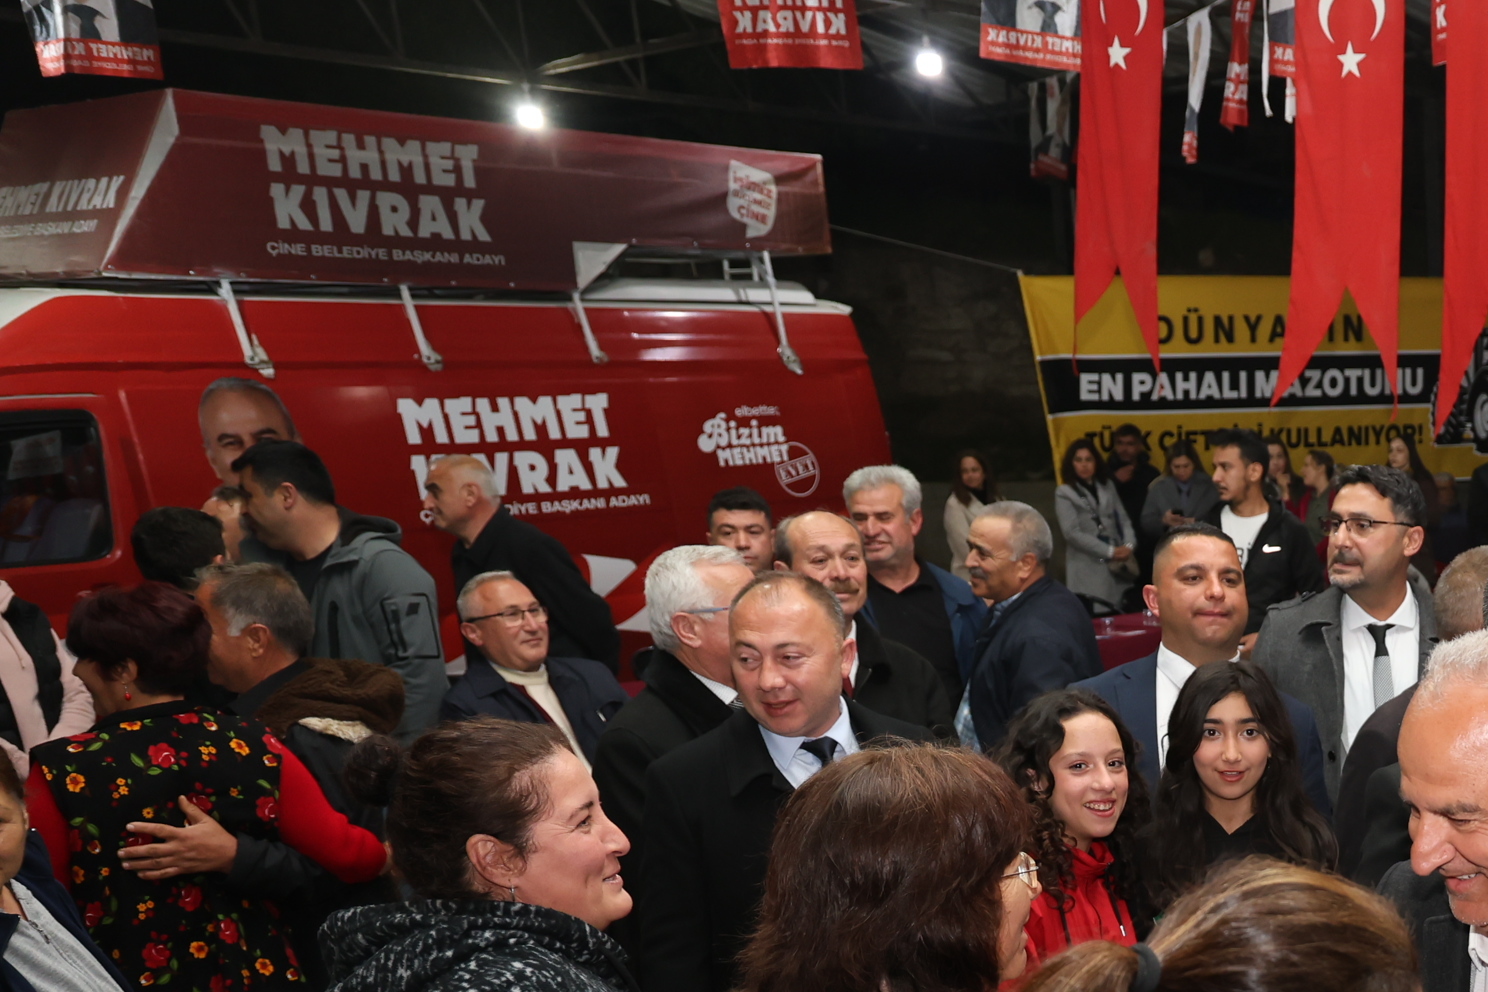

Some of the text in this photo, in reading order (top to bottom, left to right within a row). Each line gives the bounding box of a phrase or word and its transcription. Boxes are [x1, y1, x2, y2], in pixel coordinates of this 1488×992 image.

[259, 124, 479, 188] MEHMET
[45, 175, 125, 213] KIVRAK
[269, 182, 492, 242] KIVRAK
[266, 240, 506, 266] ÇİNE BELEDİYE BAŞKANI ADAYI
[1157, 307, 1363, 345] DÜNYAIN
[1079, 372, 1124, 401] EN
[1131, 370, 1248, 401] PAHALI
[396, 392, 609, 445] MEHMET
[697, 412, 787, 453] Bizim
[716, 443, 789, 467] MEHMET
[1085, 424, 1152, 453] TÜK
[779, 458, 815, 481] EVET
[541, 497, 606, 517] BAŞKANI
[609, 493, 651, 509] ADAYI
